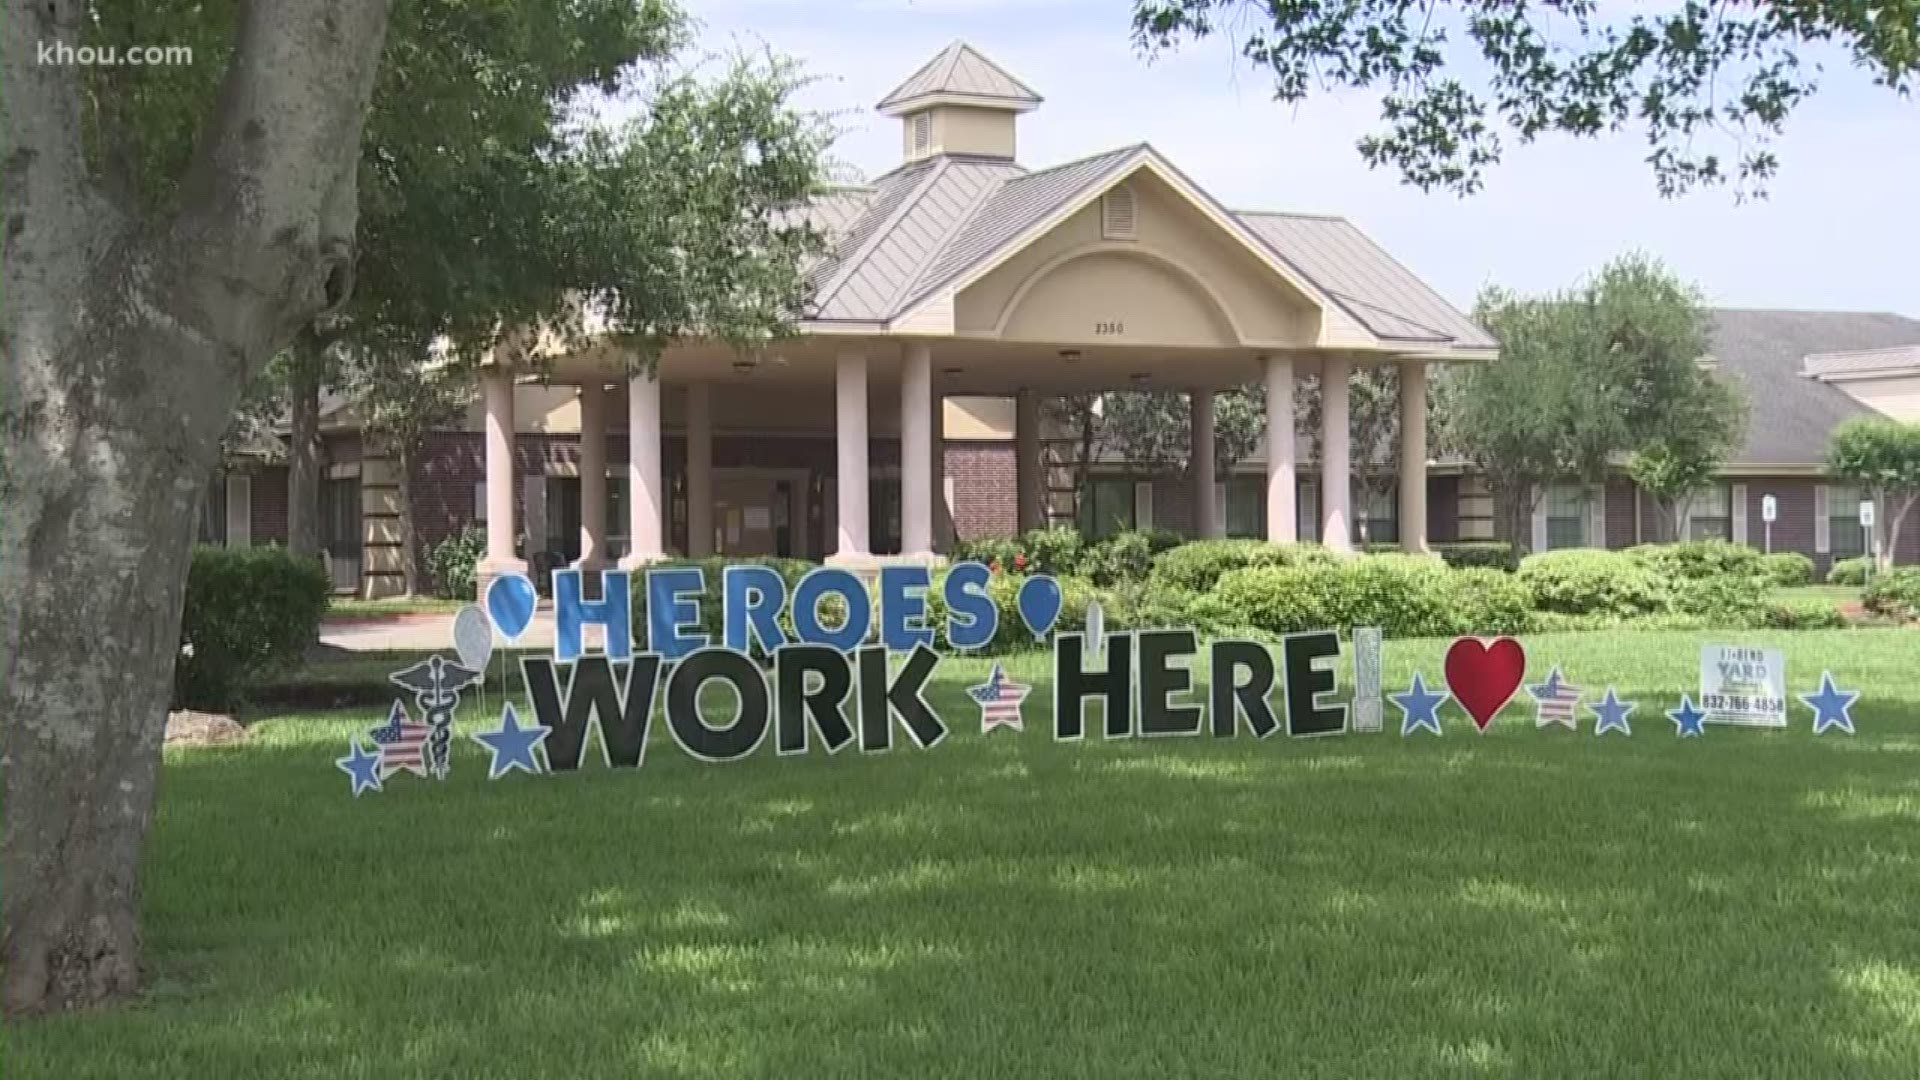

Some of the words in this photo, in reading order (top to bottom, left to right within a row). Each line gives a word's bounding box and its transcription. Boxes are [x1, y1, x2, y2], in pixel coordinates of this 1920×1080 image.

[551, 562, 1000, 663] HEROES
[519, 640, 949, 773] WORK
[1717, 662, 1767, 679] YARD
